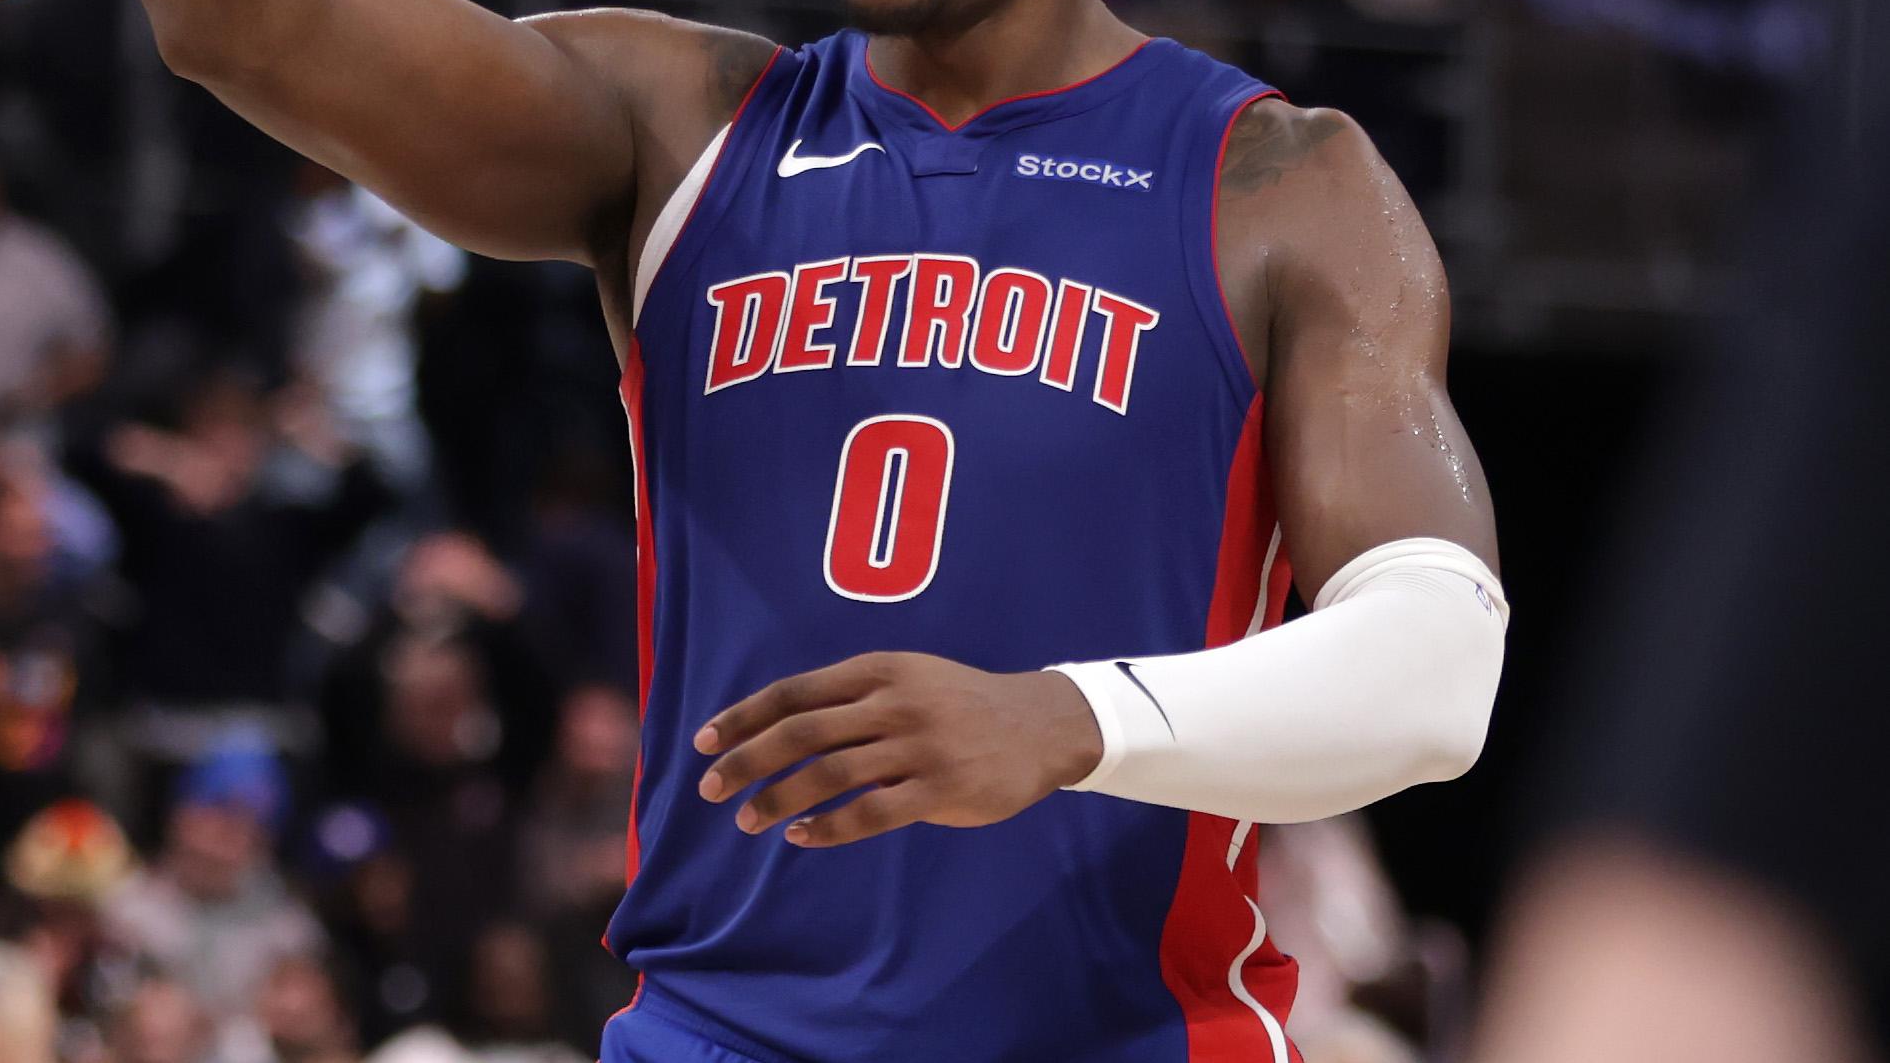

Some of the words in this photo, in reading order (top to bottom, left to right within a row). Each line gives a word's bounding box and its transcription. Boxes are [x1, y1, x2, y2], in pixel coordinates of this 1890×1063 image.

[1016, 154, 1153, 189] StockX
[704, 253, 1160, 416] DETROIT
[823, 413, 955, 603] 0
